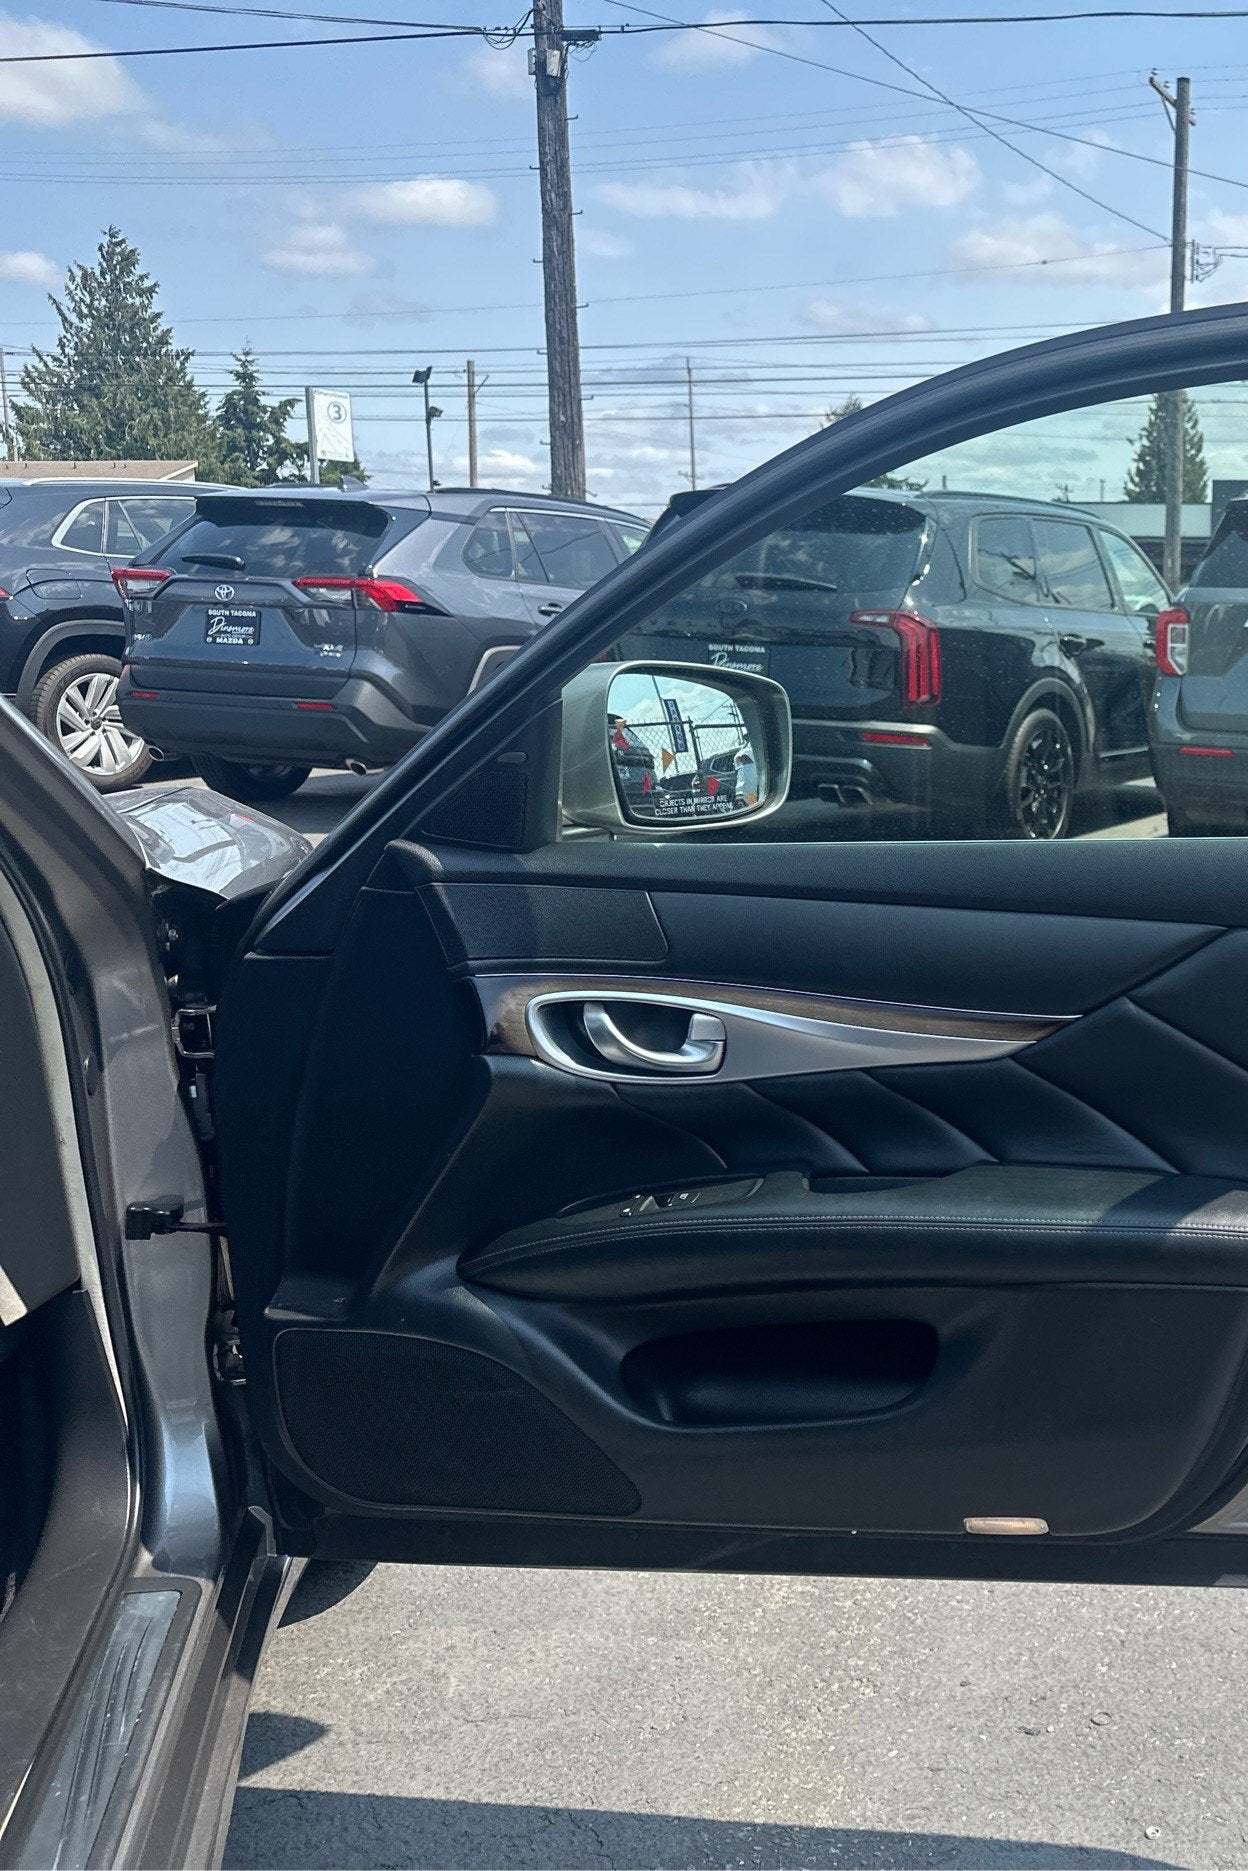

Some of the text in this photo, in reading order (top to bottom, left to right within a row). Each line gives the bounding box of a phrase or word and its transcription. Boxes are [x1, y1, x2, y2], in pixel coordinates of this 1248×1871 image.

[332, 404, 342, 421] 3
[208, 616, 255, 635] Dinsmore
[735, 644, 766, 653] TACOMA
[654, 807, 678, 816] CLOSER
[679, 805, 696, 814] THAN
[696, 804, 711, 812] THEY
